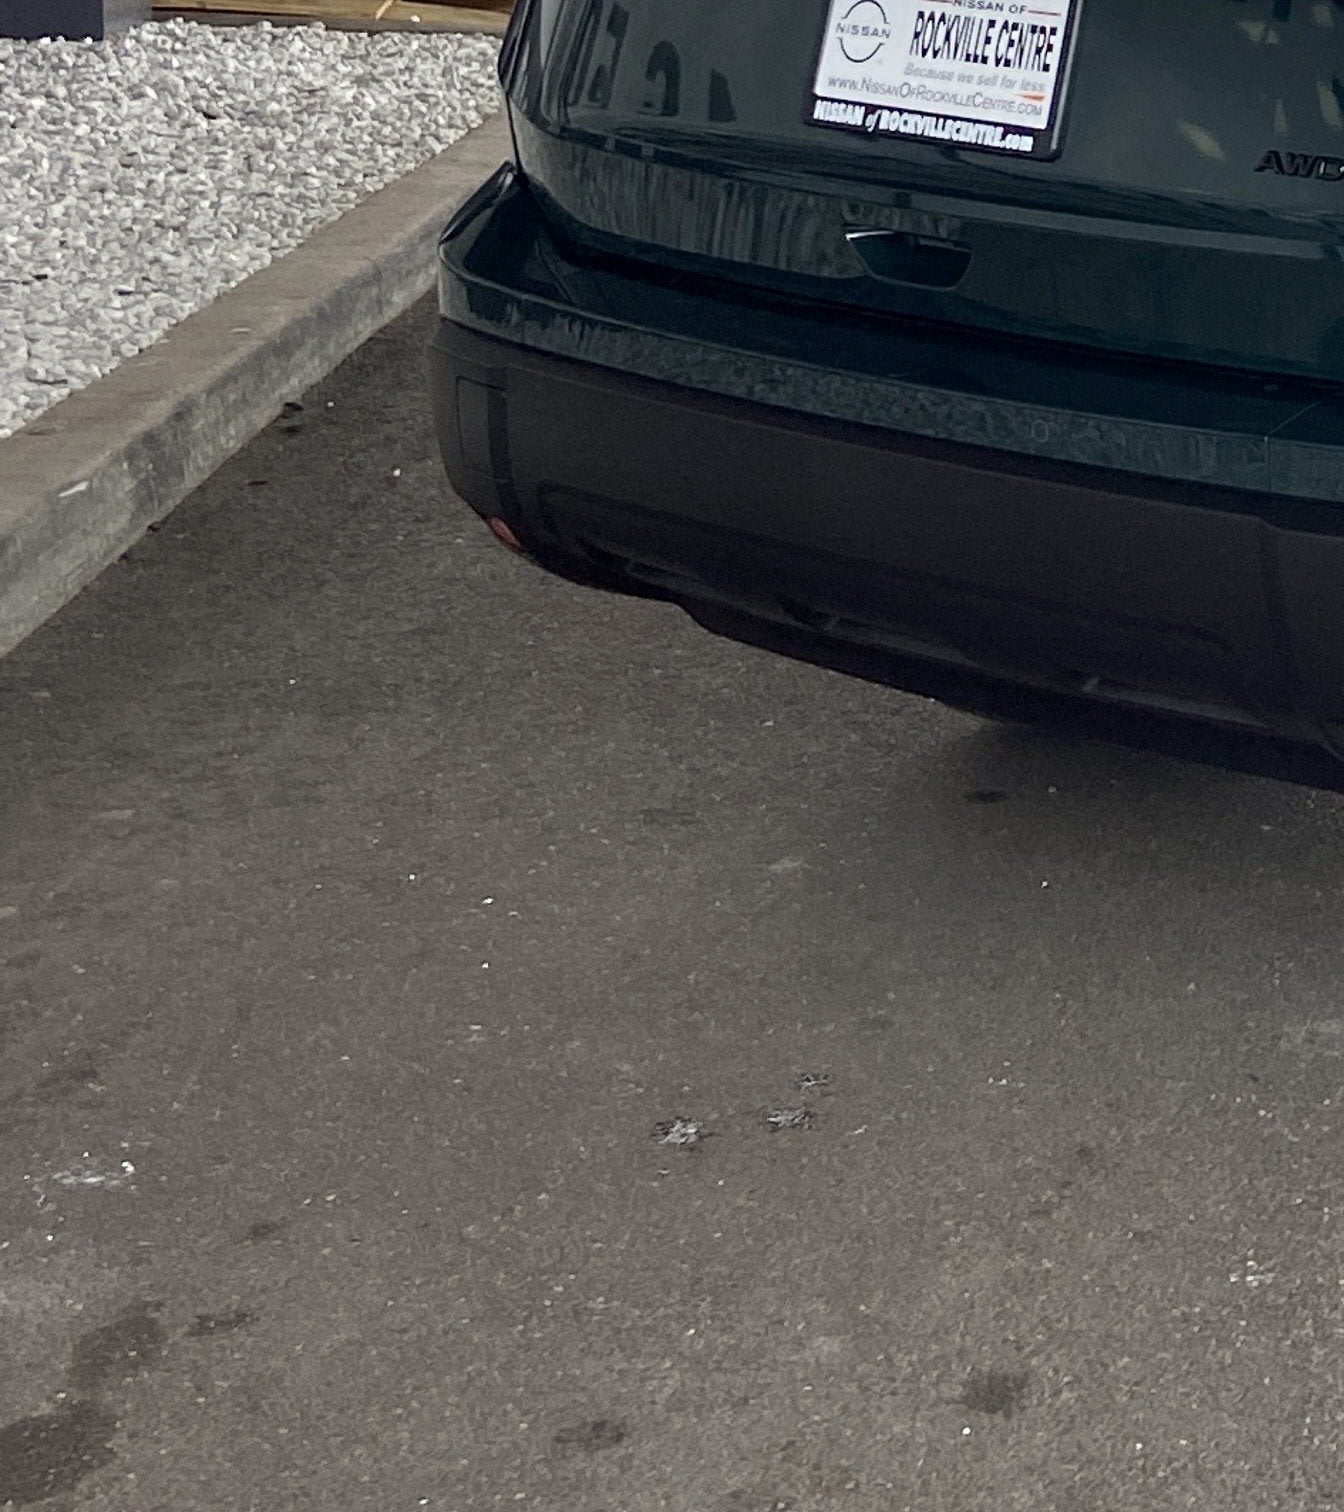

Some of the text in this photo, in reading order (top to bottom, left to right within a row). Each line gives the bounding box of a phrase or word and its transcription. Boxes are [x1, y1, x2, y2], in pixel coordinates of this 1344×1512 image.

[1008, 3, 1028, 15] OF
[835, 21, 890, 39] NISSAN
[909, 10, 1058, 73] ROCKVILLE CENTRE
[904, 62, 1046, 92] Because we sell for less
[813, 100, 865, 126] NISSAN
[865, 109, 881, 133] of
